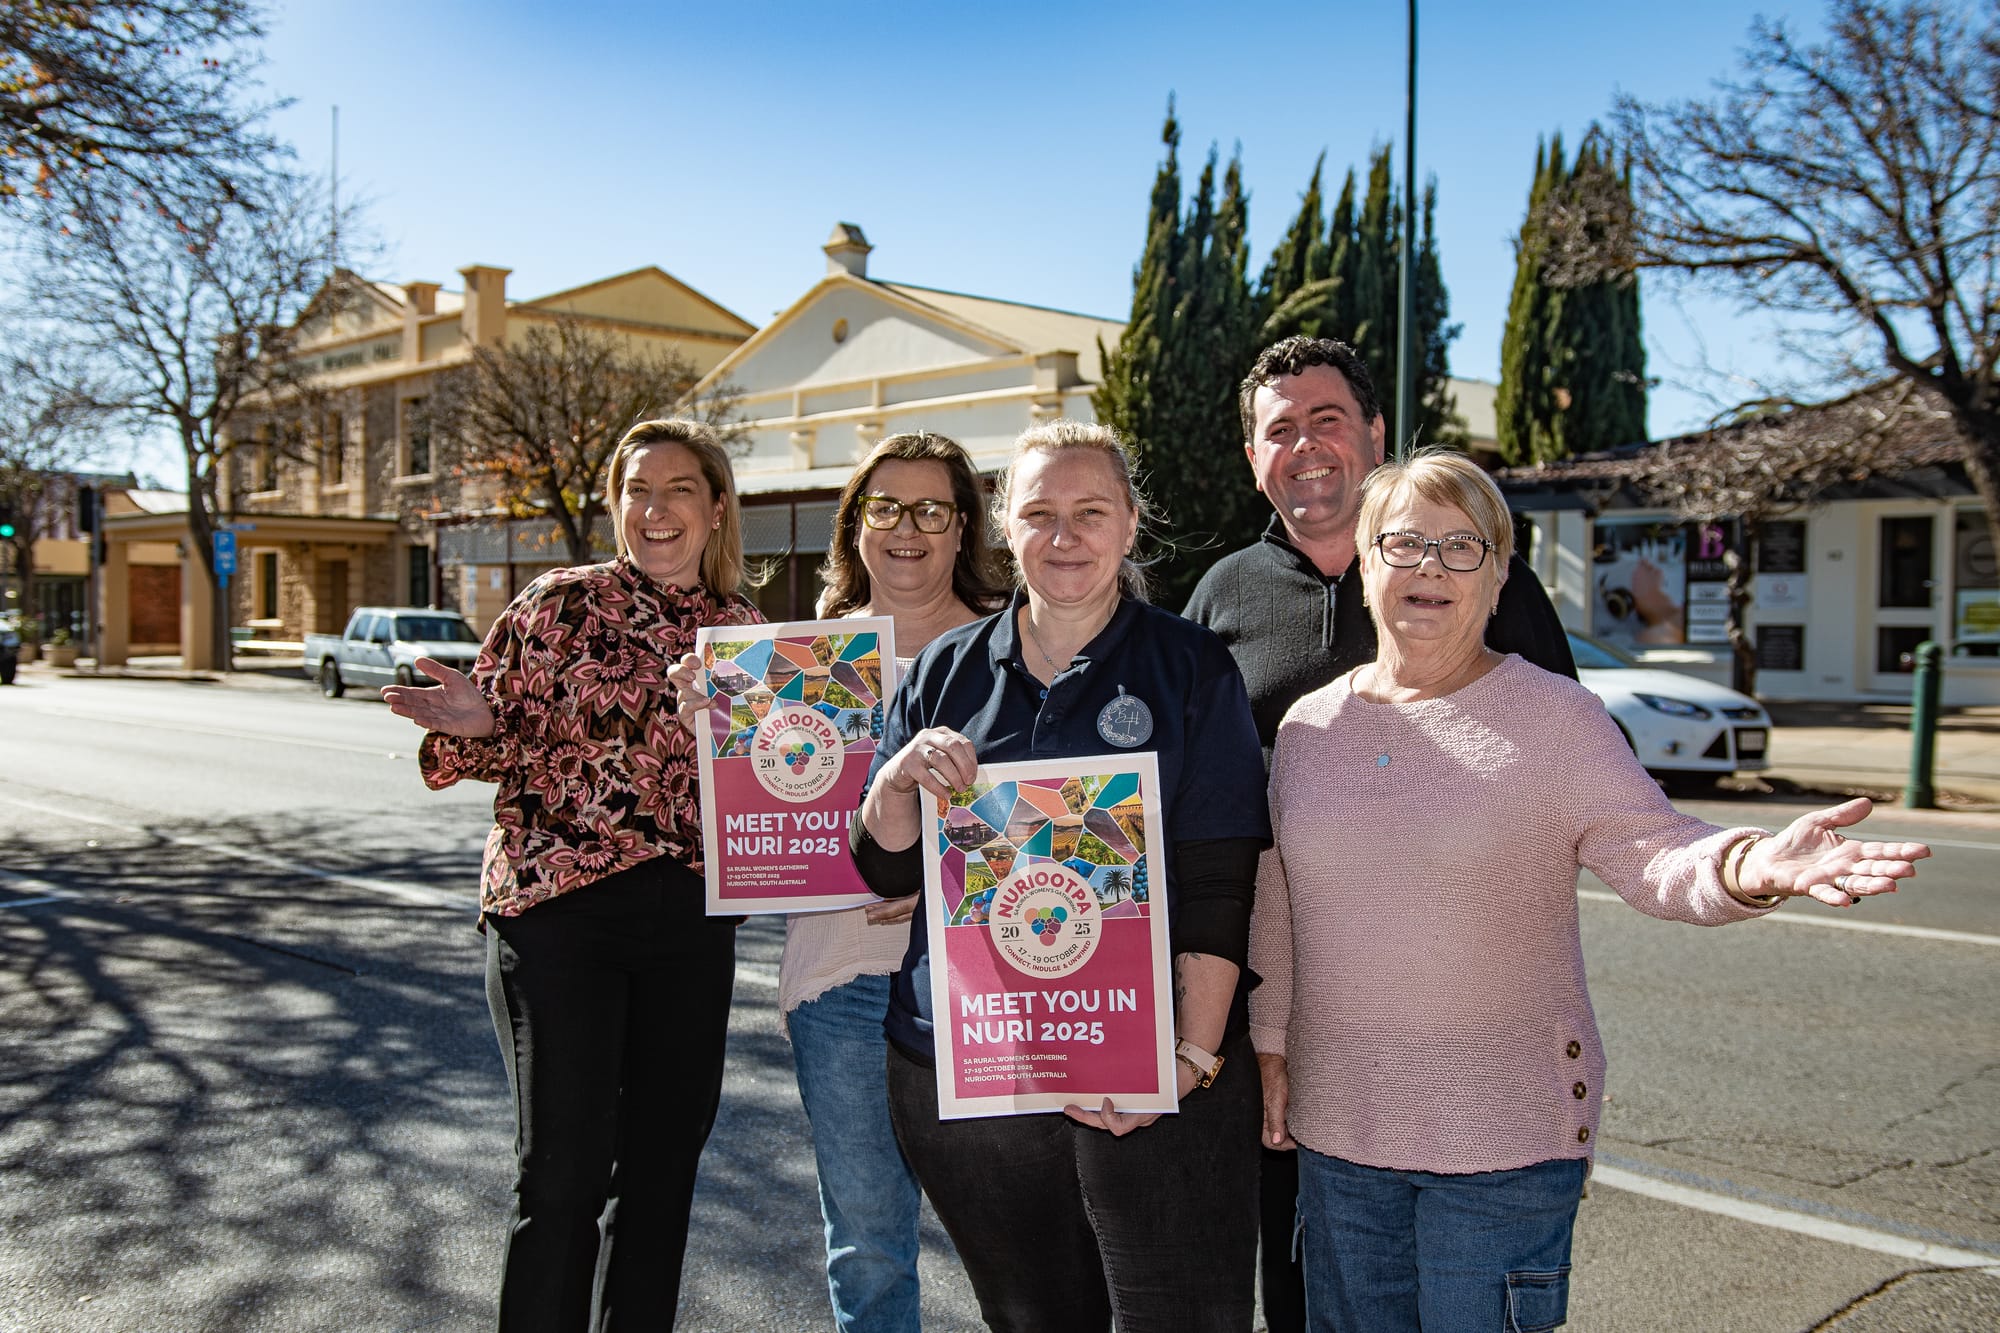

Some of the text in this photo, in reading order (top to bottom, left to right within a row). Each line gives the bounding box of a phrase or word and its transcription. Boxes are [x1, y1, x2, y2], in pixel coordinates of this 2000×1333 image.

[758, 713, 836, 751] NURIOOTPA
[760, 756, 834, 768] 20 25
[794, 773, 824, 790] OCTOBER
[815, 770, 834, 792] UNWINED
[725, 810, 858, 833] MEET YOU I
[726, 836, 840, 857] NURI 2025
[997, 871, 1092, 918] NURIOOTPA
[1030, 887, 1054, 896] WOMEN'S
[1055, 890, 1078, 913] GATHERING
[1000, 922, 1091, 938] 20 25
[1018, 947, 1028, 956] 17
[1033, 955, 1042, 964] 19
[1043, 943, 1079, 964] OCTOBER
[1032, 964, 1062, 972] INDULGE
[1068, 940, 1091, 966] UNWINED
[961, 988, 1137, 1018] MEET YOU IN
[962, 1018, 1105, 1045] NURI 2025
[973, 1057, 996, 1065] RURAL
[997, 1055, 1030, 1063] WOMEN'S
